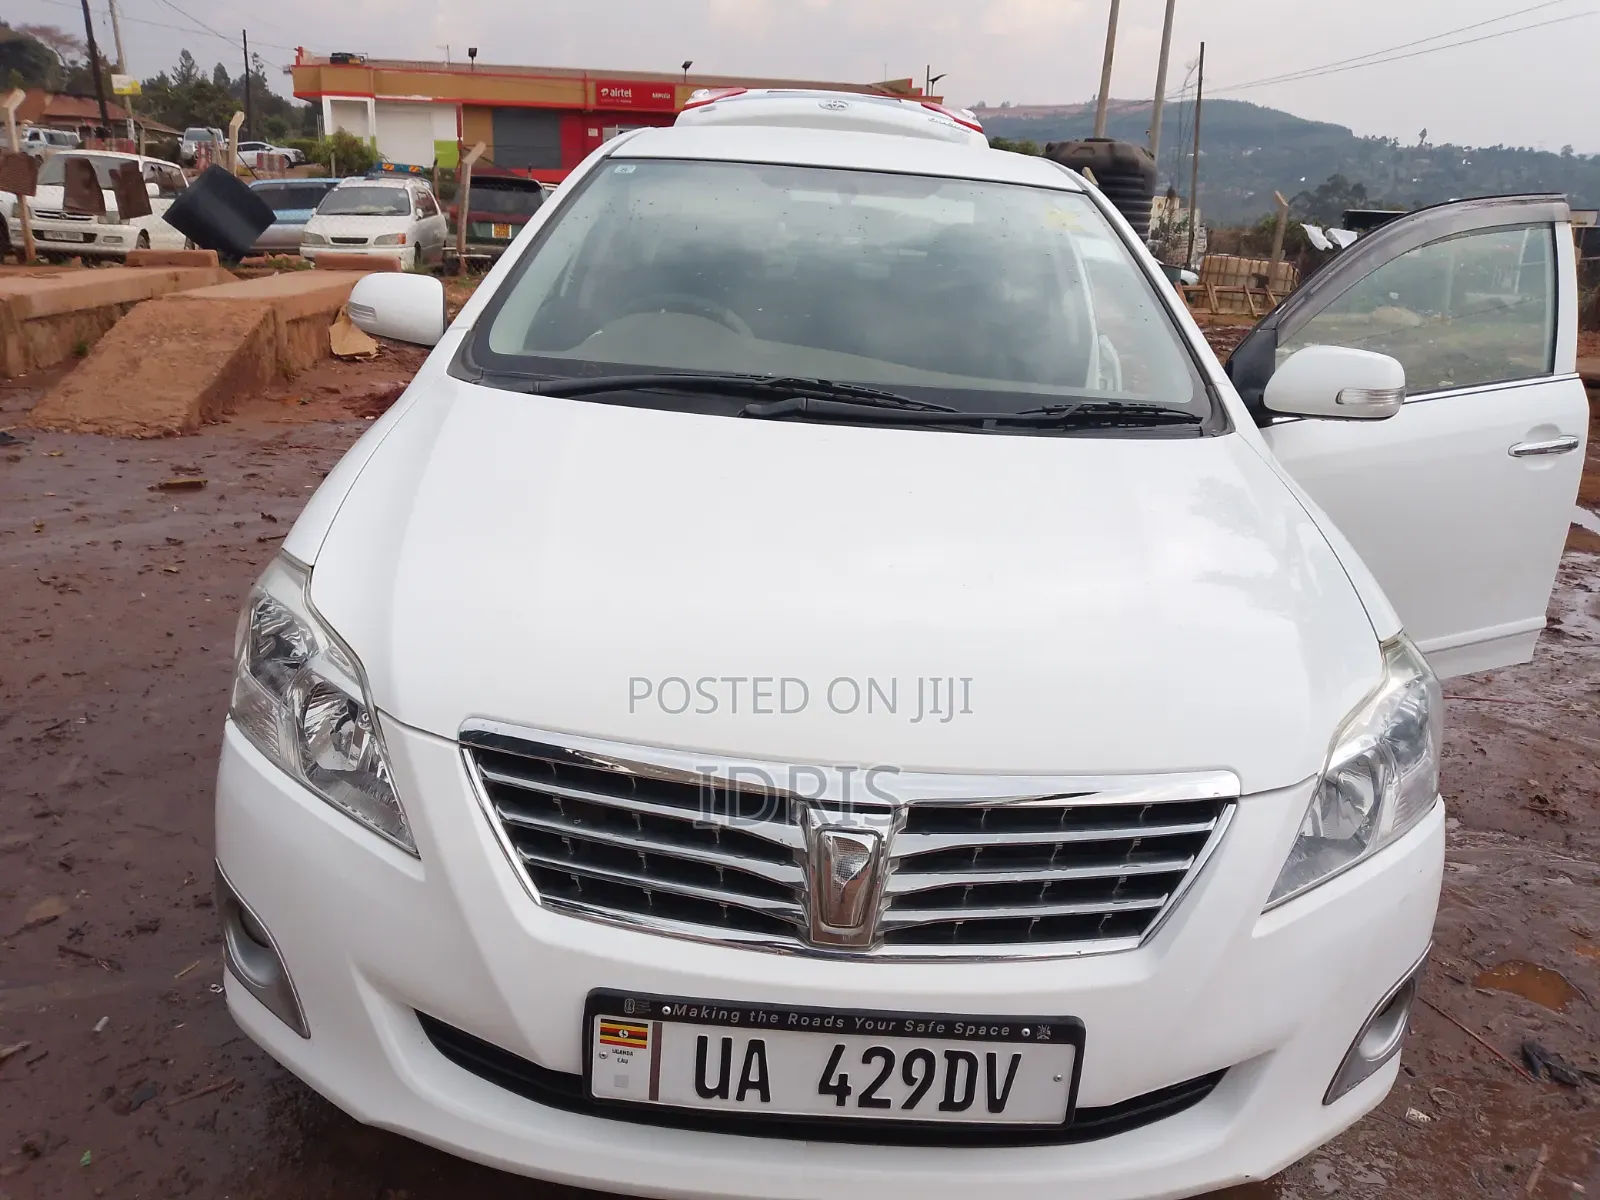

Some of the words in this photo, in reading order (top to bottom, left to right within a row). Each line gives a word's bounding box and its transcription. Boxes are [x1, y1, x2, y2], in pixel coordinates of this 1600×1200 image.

[610, 88, 632, 97] airtel
[672, 1004, 740, 1023] Making
[750, 1010, 779, 1024] the
[787, 1013, 844, 1028] Roads
[854, 1017, 896, 1031] Your
[904, 1019, 945, 1034] Safe
[954, 1022, 1010, 1037] Space
[695, 1035, 771, 1102] UA
[818, 1044, 1022, 1113] 429DV
